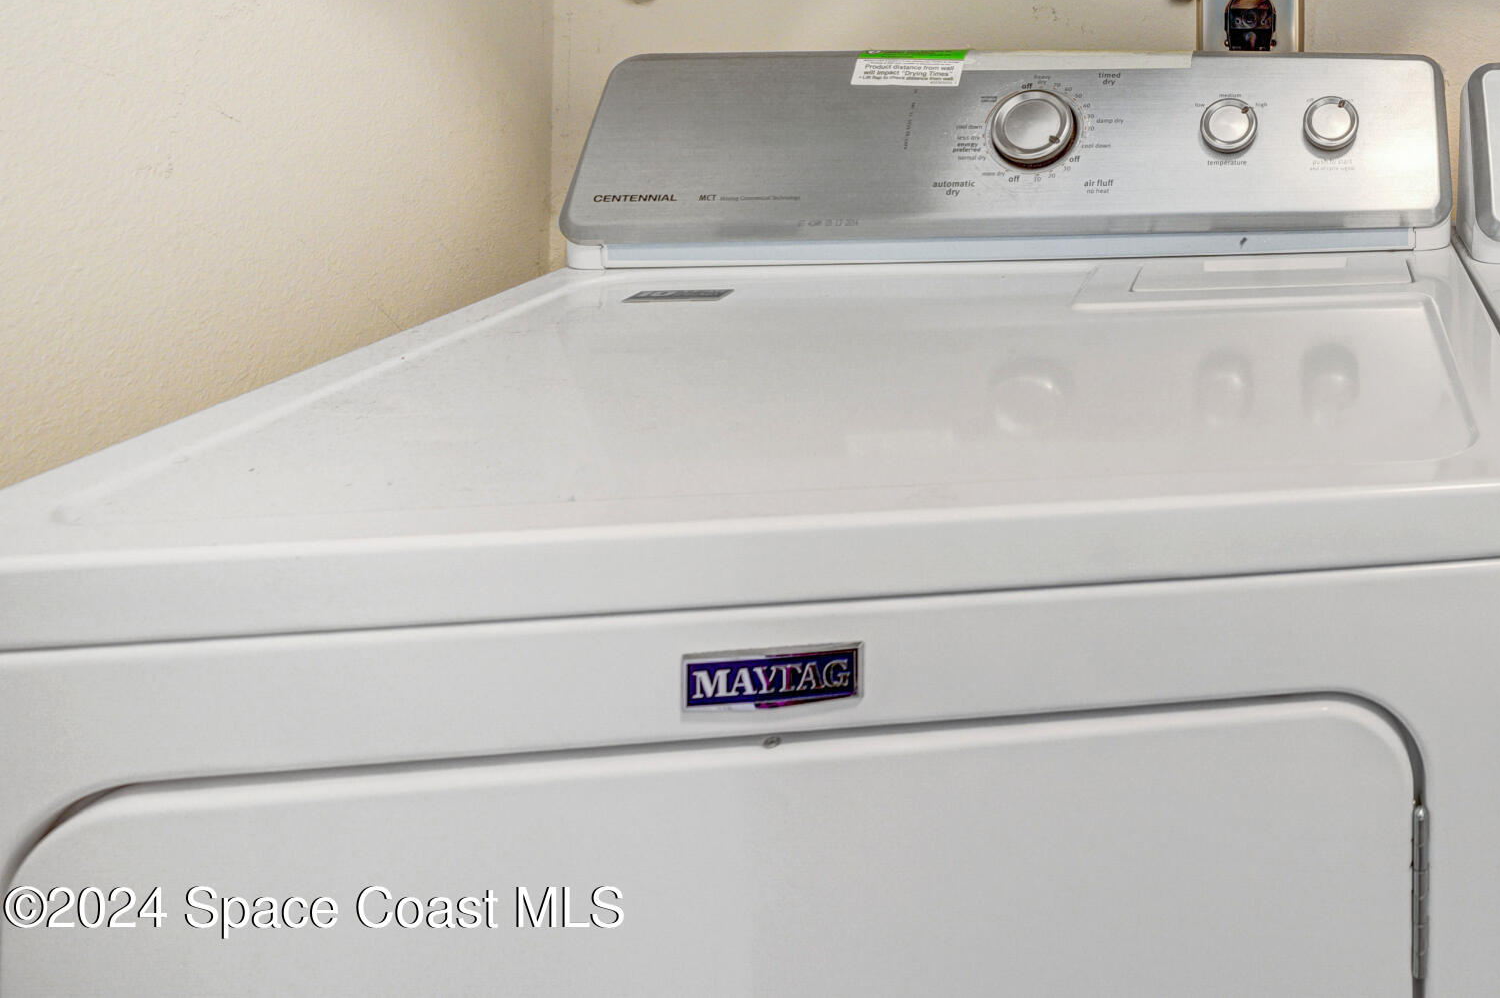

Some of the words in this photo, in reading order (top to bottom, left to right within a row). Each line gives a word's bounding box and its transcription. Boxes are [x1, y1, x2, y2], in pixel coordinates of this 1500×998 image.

[1098, 71, 1121, 80] timed
[1021, 82, 1033, 90] off
[1102, 78, 1116, 87] dry
[1069, 155, 1080, 163] off
[1207, 159, 1247, 167] temperature
[1008, 175, 1020, 183] off
[1097, 179, 1114, 187] fluff
[932, 179, 975, 188] automatic
[946, 188, 960, 197] dry
[593, 194, 678, 202] CENTENNIAL
[691, 658, 851, 699] MAYTAG
